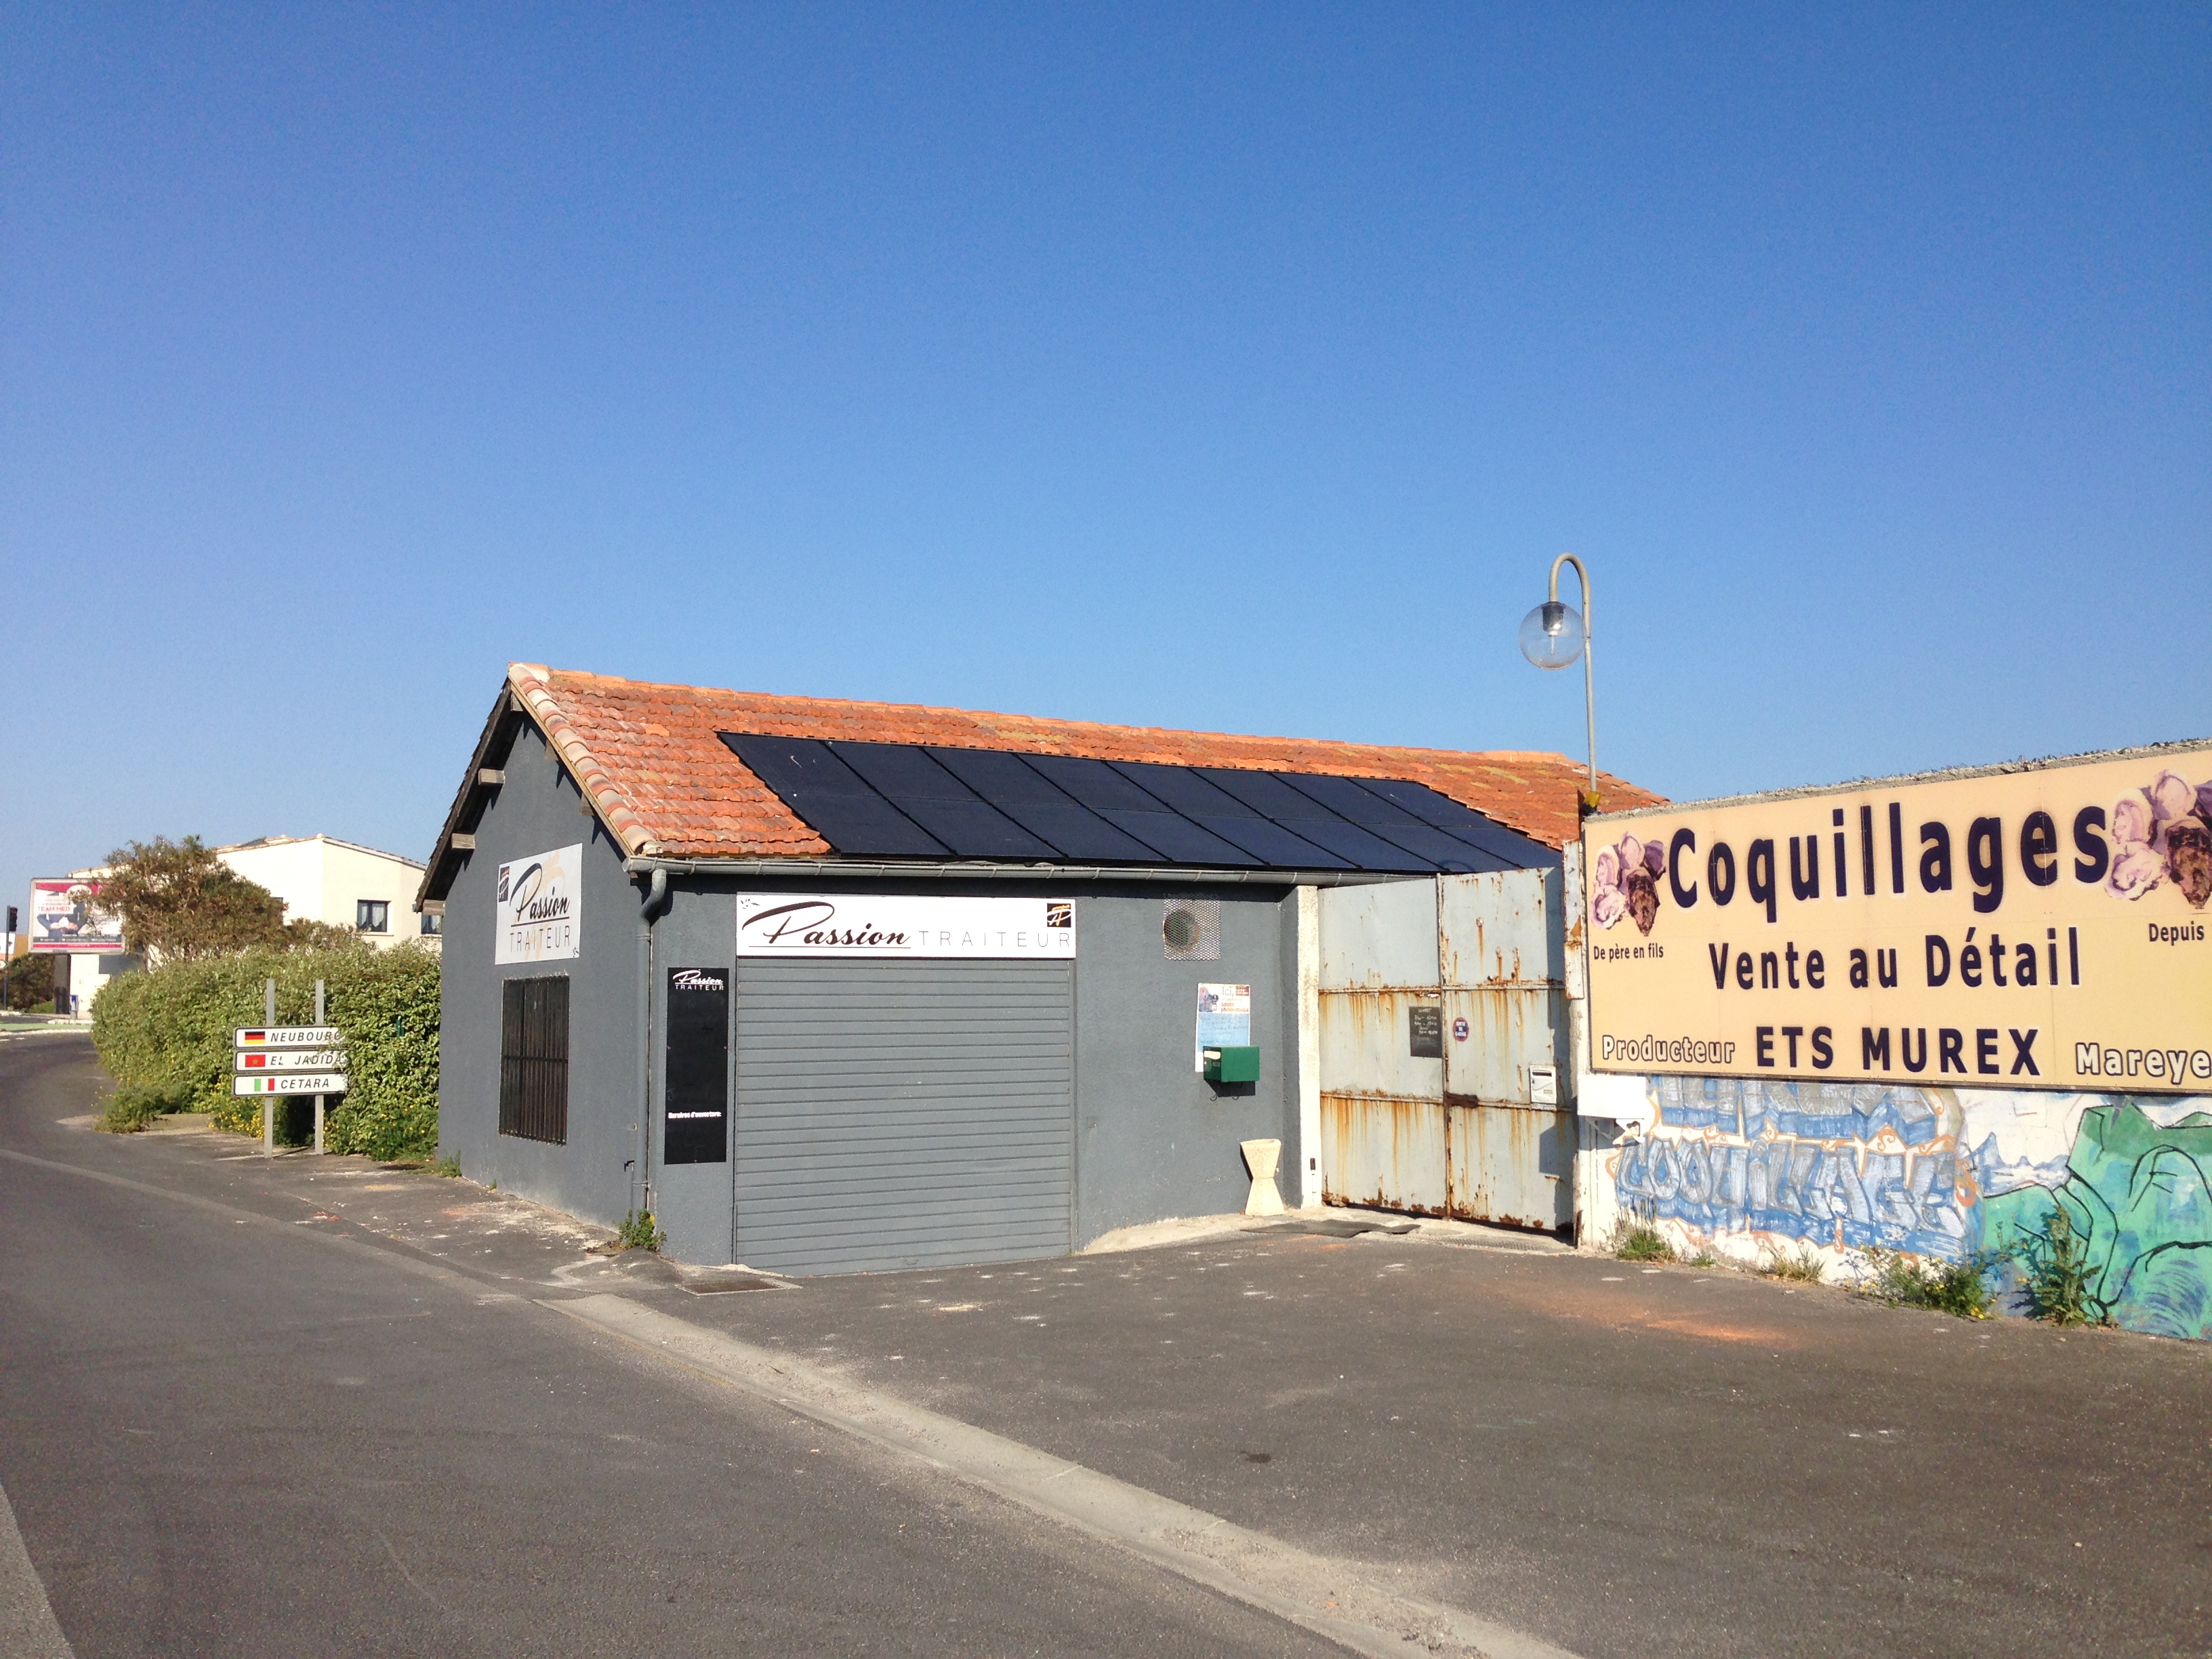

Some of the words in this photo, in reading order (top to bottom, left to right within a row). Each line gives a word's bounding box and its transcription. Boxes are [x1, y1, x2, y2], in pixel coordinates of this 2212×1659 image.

[1668, 802, 2110, 923] Coquillages
[510, 863, 570, 922] Passion
[742, 901, 910, 945] Passion
[919, 931, 1069, 947] TRAITEUR
[2148, 920, 2205, 946] Depuis
[510, 925, 571, 952] TRAITEUR
[1594, 946, 1605, 960] De
[1609, 943, 1630, 963] père
[1633, 947, 1644, 958] en
[1648, 943, 1664, 958] fils
[1708, 941, 1825, 990] Vente
[1849, 948, 1898, 989] au
[1925, 926, 2080, 987] Détail
[672, 970, 724, 984] Passion
[270, 1056, 284, 1065] EL
[1602, 1035, 1736, 1065] Producteur
[1756, 1025, 1834, 1069] ETS
[1862, 1027, 2041, 1076] MUREX
[2075, 1042, 2212, 1084] Mareye
[281, 1078, 329, 1089] CETARA
